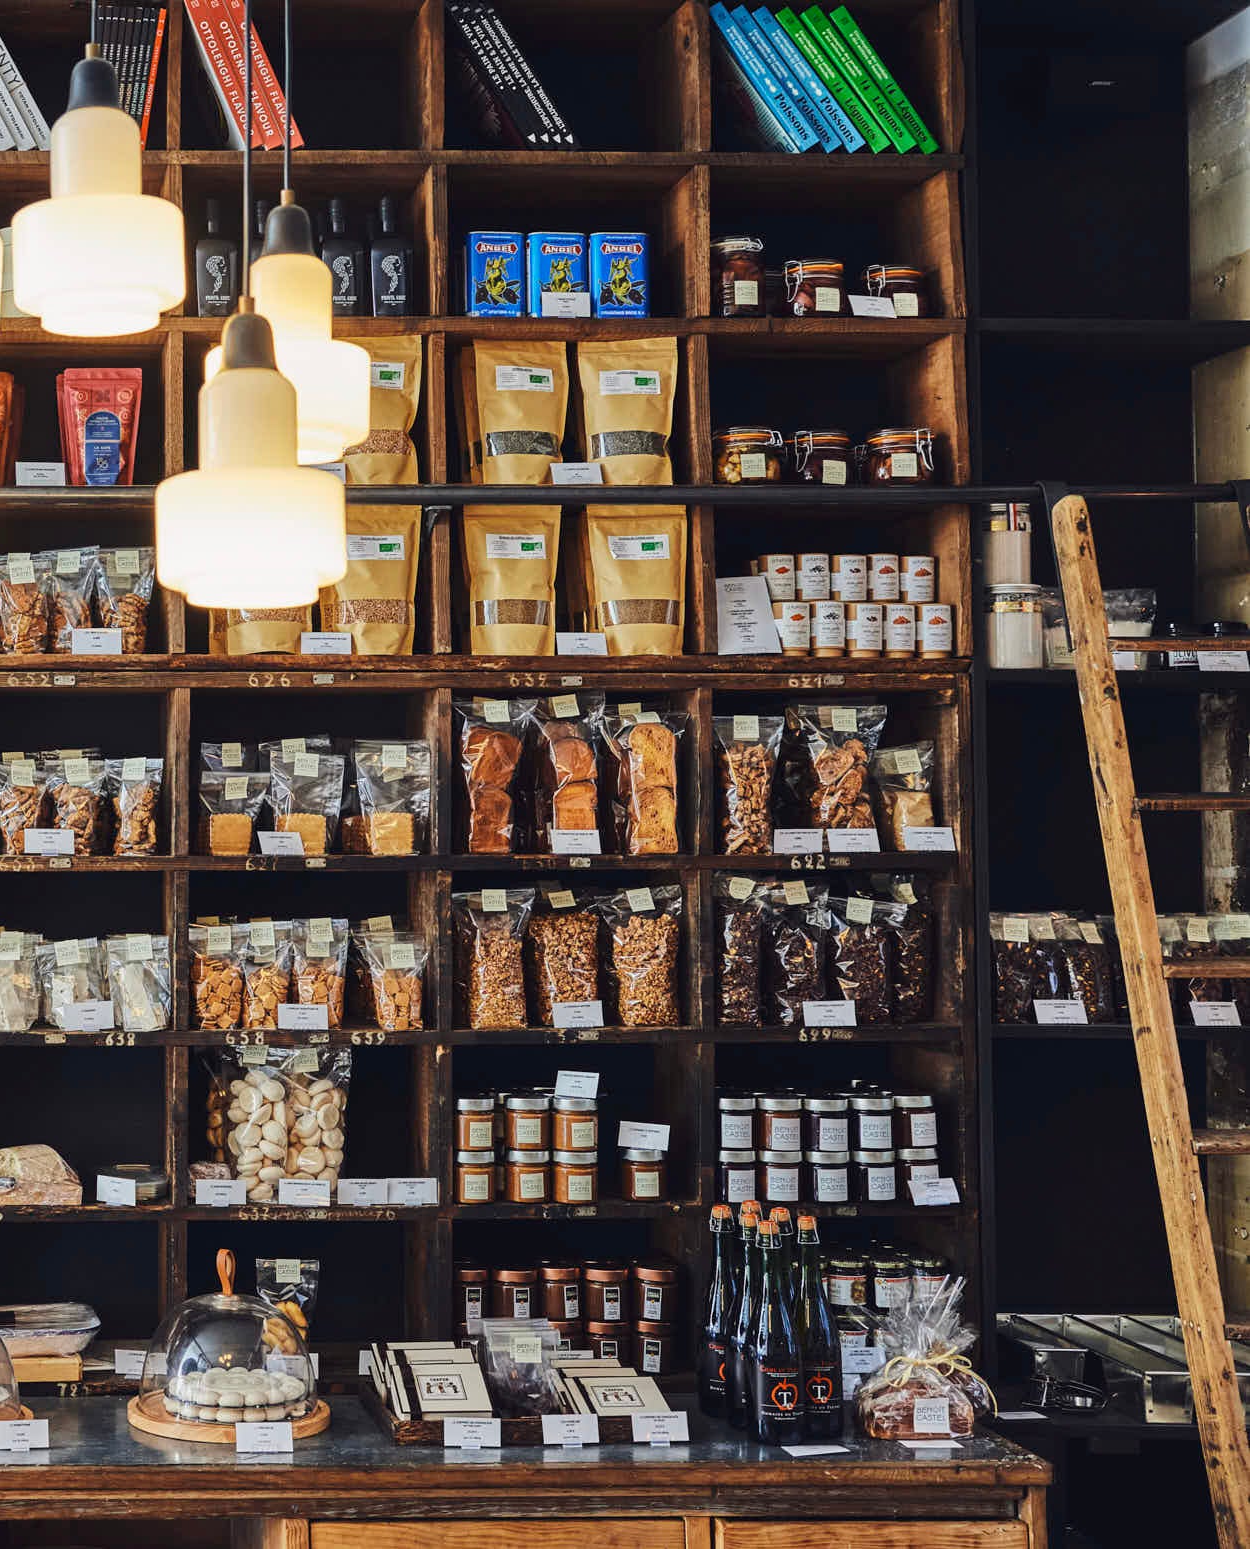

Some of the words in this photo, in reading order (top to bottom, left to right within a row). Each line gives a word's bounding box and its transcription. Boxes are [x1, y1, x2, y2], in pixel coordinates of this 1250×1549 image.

[200, 20, 234, 88] OTTOLENGHI
[481, 55, 495, 75] PAIN
[493, 56, 508, 75] PAIN
[774, 93, 810, 141] Poissons
[797, 96, 832, 144] Poissons
[820, 96, 856, 144] Poissons
[916, 1413, 946, 1421] CASTEL
